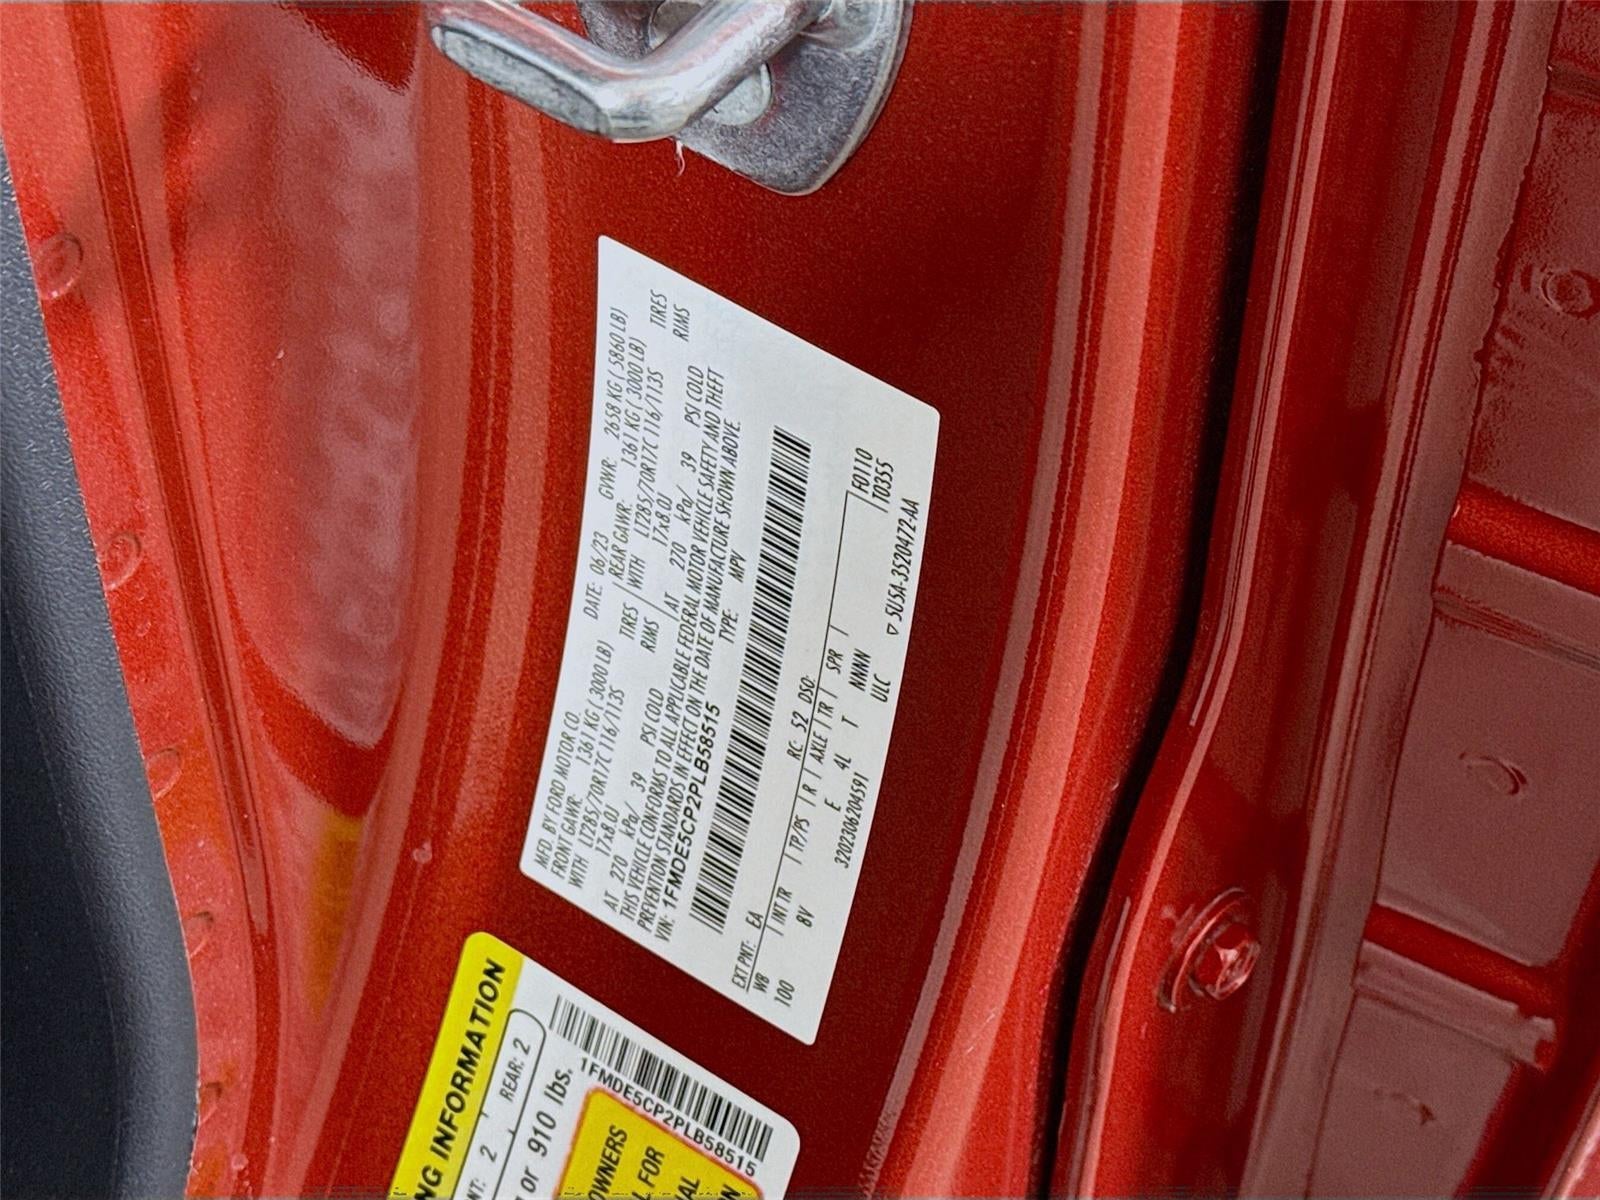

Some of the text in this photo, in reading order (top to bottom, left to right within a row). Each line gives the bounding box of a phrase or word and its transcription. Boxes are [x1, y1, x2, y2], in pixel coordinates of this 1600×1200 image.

[609, 306, 628, 333] LB)
[649, 289, 668, 330] TIRES
[672, 304, 690, 342] RIMS
[608, 332, 626, 371] 5860
[628, 336, 648, 363] LB)
[606, 379, 623, 403] KG
[626, 361, 644, 401] 3000
[603, 402, 622, 441] 2658
[624, 408, 641, 432] KG
[620, 432, 639, 468] 1361
[598, 456, 618, 500] GVWR:
[626, 366, 664, 590] WITH LT285/70R17C 116/113S
[664, 365, 704, 614] AT 270 kPa/ 39 PSI COLD
[612, 499, 633, 544] GAWR:
[652, 491, 673, 548] 17x8.0J
[583, 530, 610, 621] DATE: 06/23
[608, 543, 628, 581] REAR
[884, 498, 920, 622] 5U5A-3520472-AA
[718, 549, 747, 644] TYPE: MPV
[619, 602, 639, 641] TIRES
[619, 366, 725, 922] THIS VEHICLE CONFORMS TO ALL APPLICABLE FEDERAL MOTOR VEHICLE SAFETY AND THEFT
[640, 616, 660, 654] RIMS
[595, 639, 614, 665] LB)
[589, 663, 609, 701] 3000
[637, 418, 741, 933] PREVENTION STANDARDS IN EFFECT ON THE DATE OF MANUFACTURE SHOWN ABOVE.
[870, 673, 892, 703] ULC
[583, 708, 600, 732] KG
[790, 710, 809, 734] 52
[576, 730, 596, 766] 1361
[534, 711, 582, 870] MFD. BY FORD MOTOR CO.
[568, 684, 625, 889] WITH LT285/70R17C 116/113S
[603, 687, 664, 913] AT 270 kPa/ 39 PSI COLD
[560, 794, 583, 836] GAWR:
[595, 804, 620, 857] 17x8.0J
[654, 701, 720, 942] VIN: 1FMDE5CP2PLB58515
[753, 648, 844, 993] WB INT TR TP/PS R AXLE TR SPR
[774, 648, 871, 1008] 100 8V E 4L T NNNN
[834, 771, 870, 869] 3202306204591
[550, 834, 573, 880] FRONT
[731, 910, 764, 990] EXT PNT: EA
[430, 958, 505, 1160] INFORMATION
[480, 1145, 497, 1163] 2
[499, 1057, 525, 1103] REAR:
[513, 1038, 531, 1055] 2
[580, 1057, 757, 1177] 1FMDE5CP2PLB58515
[520, 1068, 574, 1193] or 910 lbs.
[637, 1146, 665, 1188] FOR
